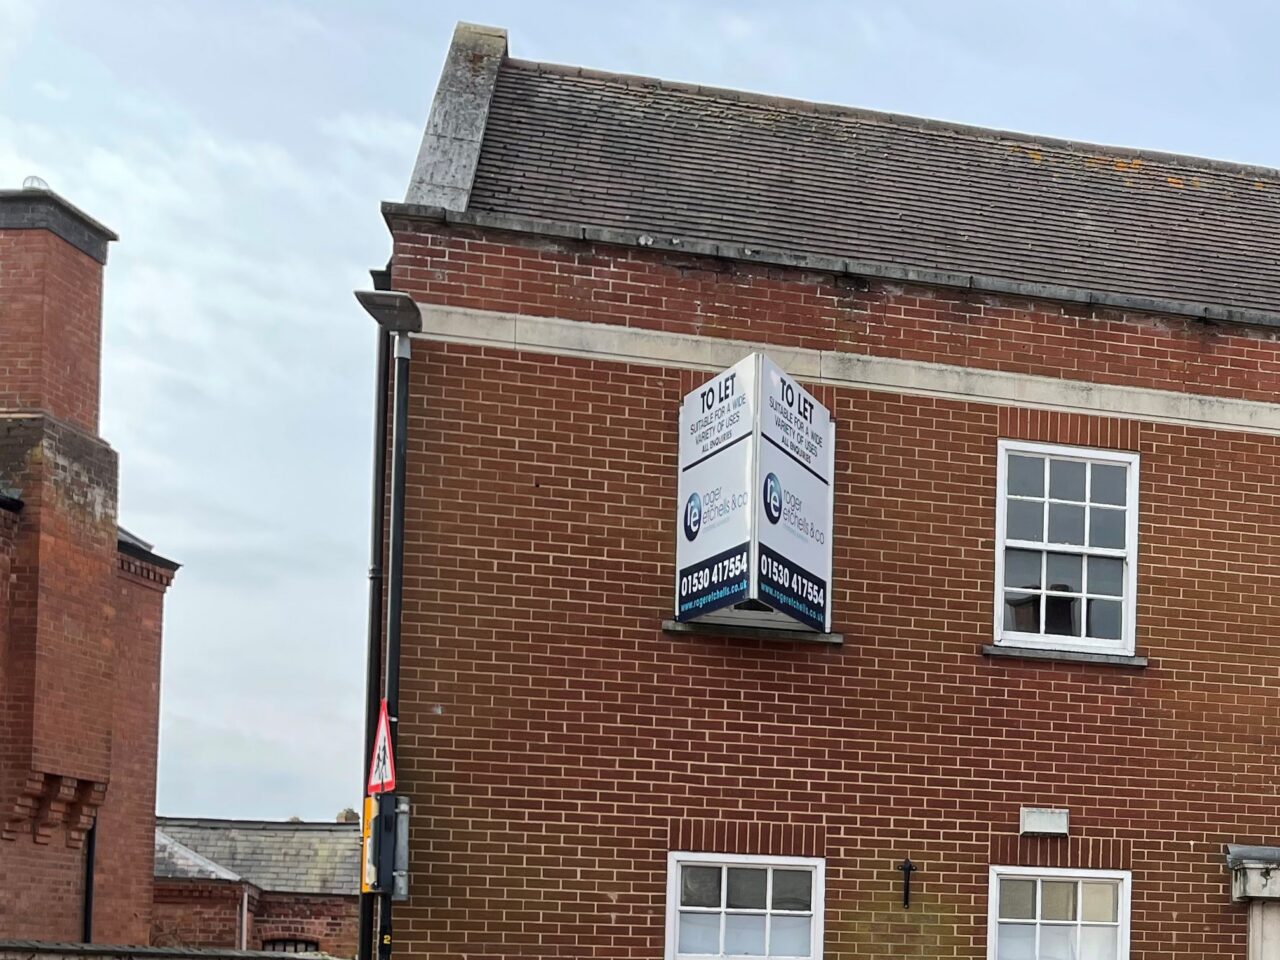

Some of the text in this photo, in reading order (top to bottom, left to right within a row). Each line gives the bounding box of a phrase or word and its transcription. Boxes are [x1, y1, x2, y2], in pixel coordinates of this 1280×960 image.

[701, 372, 736, 414] TO LET
[780, 377, 814, 424] TO LET
[690, 412, 714, 435] SUITABLE
[714, 405, 725, 420] FOR
[732, 393, 746, 410] WIDE
[695, 411, 740, 445] VARIETY OF USES
[769, 395, 794, 424] SUITABLE
[794, 416, 805, 432] FOR
[811, 430, 823, 448] WIDE
[710, 429, 732, 449] ENQUIRIES
[774, 414, 818, 457] VARIETY OF USES
[781, 435, 812, 464] ALL ENQUIRIES
[702, 492, 748, 524] etchells & co
[703, 486, 722, 508] roger
[784, 489, 802, 512] roger
[783, 507, 809, 535] etchells
[815, 529, 825, 545] co
[681, 551, 747, 597] 01530 417554
[761, 554, 824, 607] 01530 417554
[681, 579, 747, 612] www.rogeretchells.co.uk
[760, 582, 824, 622] www.rogeretchells.co.uk
[383, 934, 391, 945] 2
